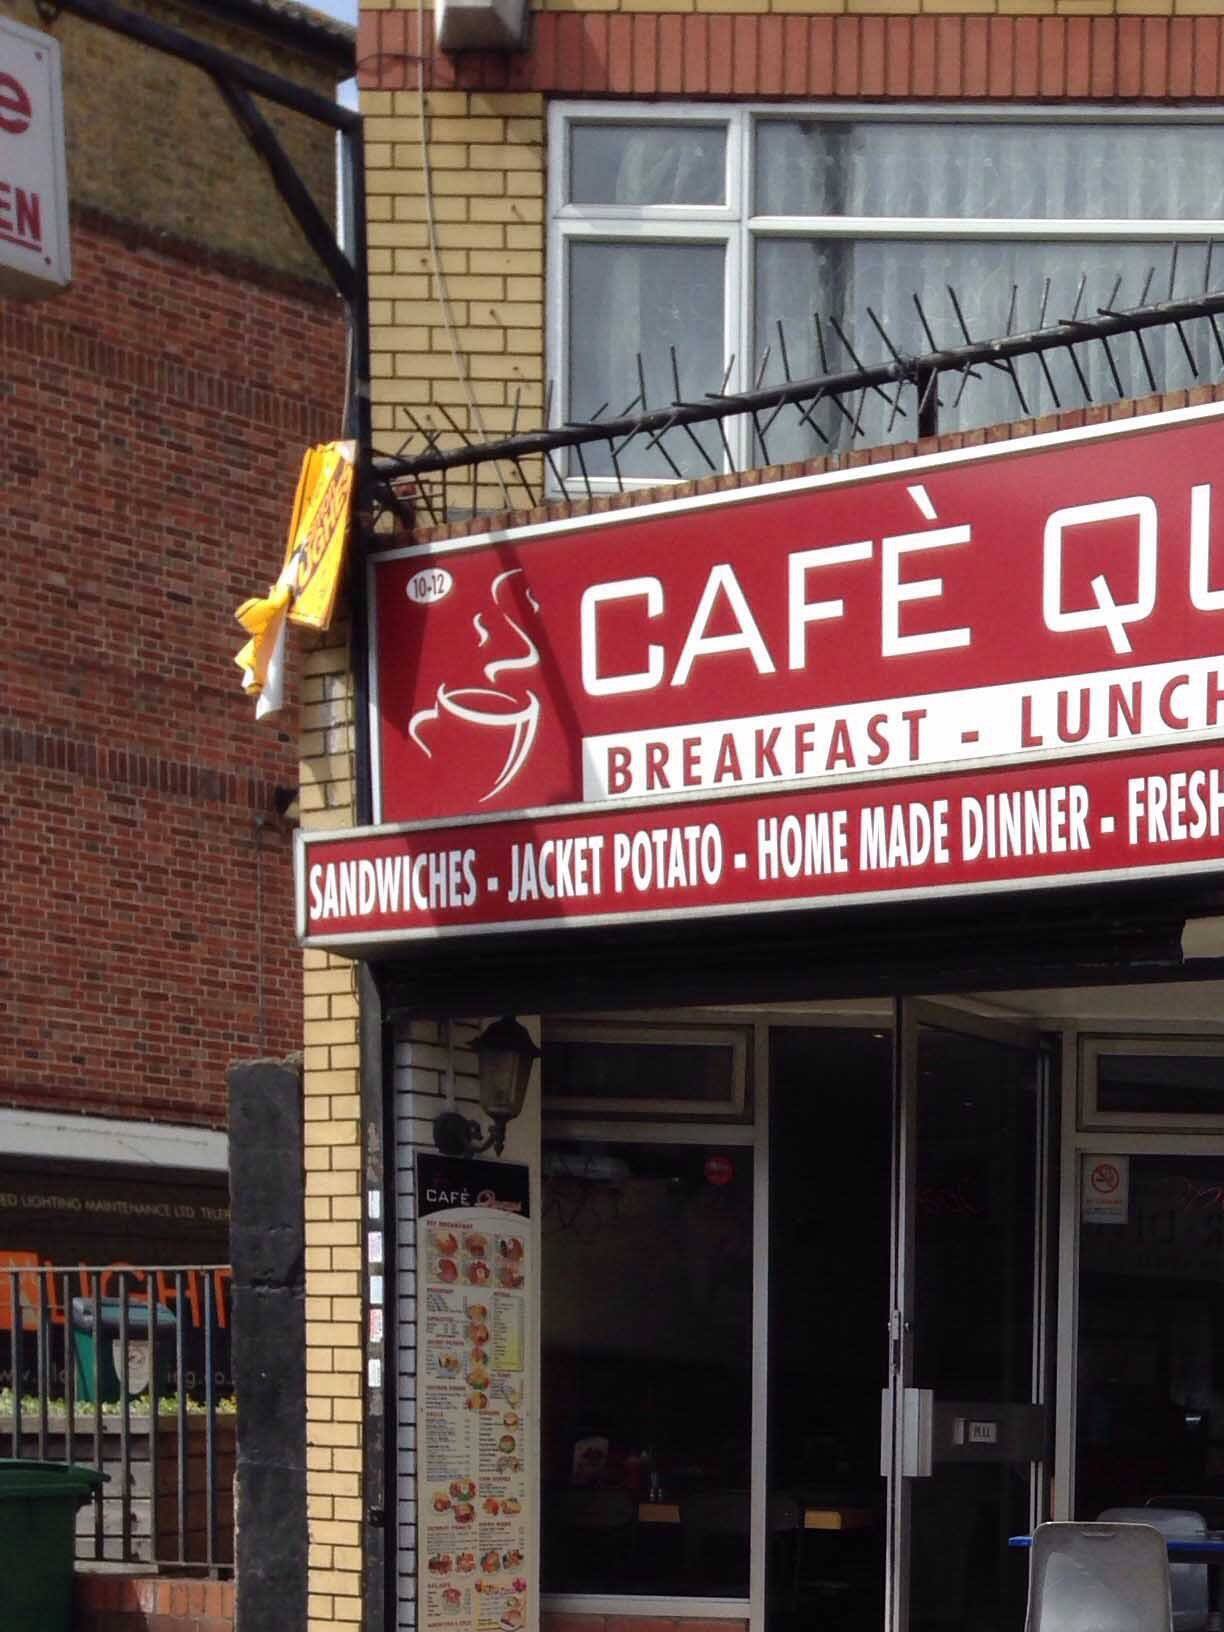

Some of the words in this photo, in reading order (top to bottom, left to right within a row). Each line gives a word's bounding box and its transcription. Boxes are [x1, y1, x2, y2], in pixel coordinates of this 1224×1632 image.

[413, 573, 445, 599] 10-12
[580, 484, 971, 697] CAFÈ
[606, 708, 928, 795] BREAKFAST
[309, 848, 477, 921] SANDWICHES
[508, 835, 605, 904] JACKET
[613, 823, 723, 893] POTATO
[757, 810, 848, 880] HOME
[859, 799, 950, 871] MADE
[960, 784, 1091, 862] DINNER
[22, 1193, 82, 1211] LIGHTING
